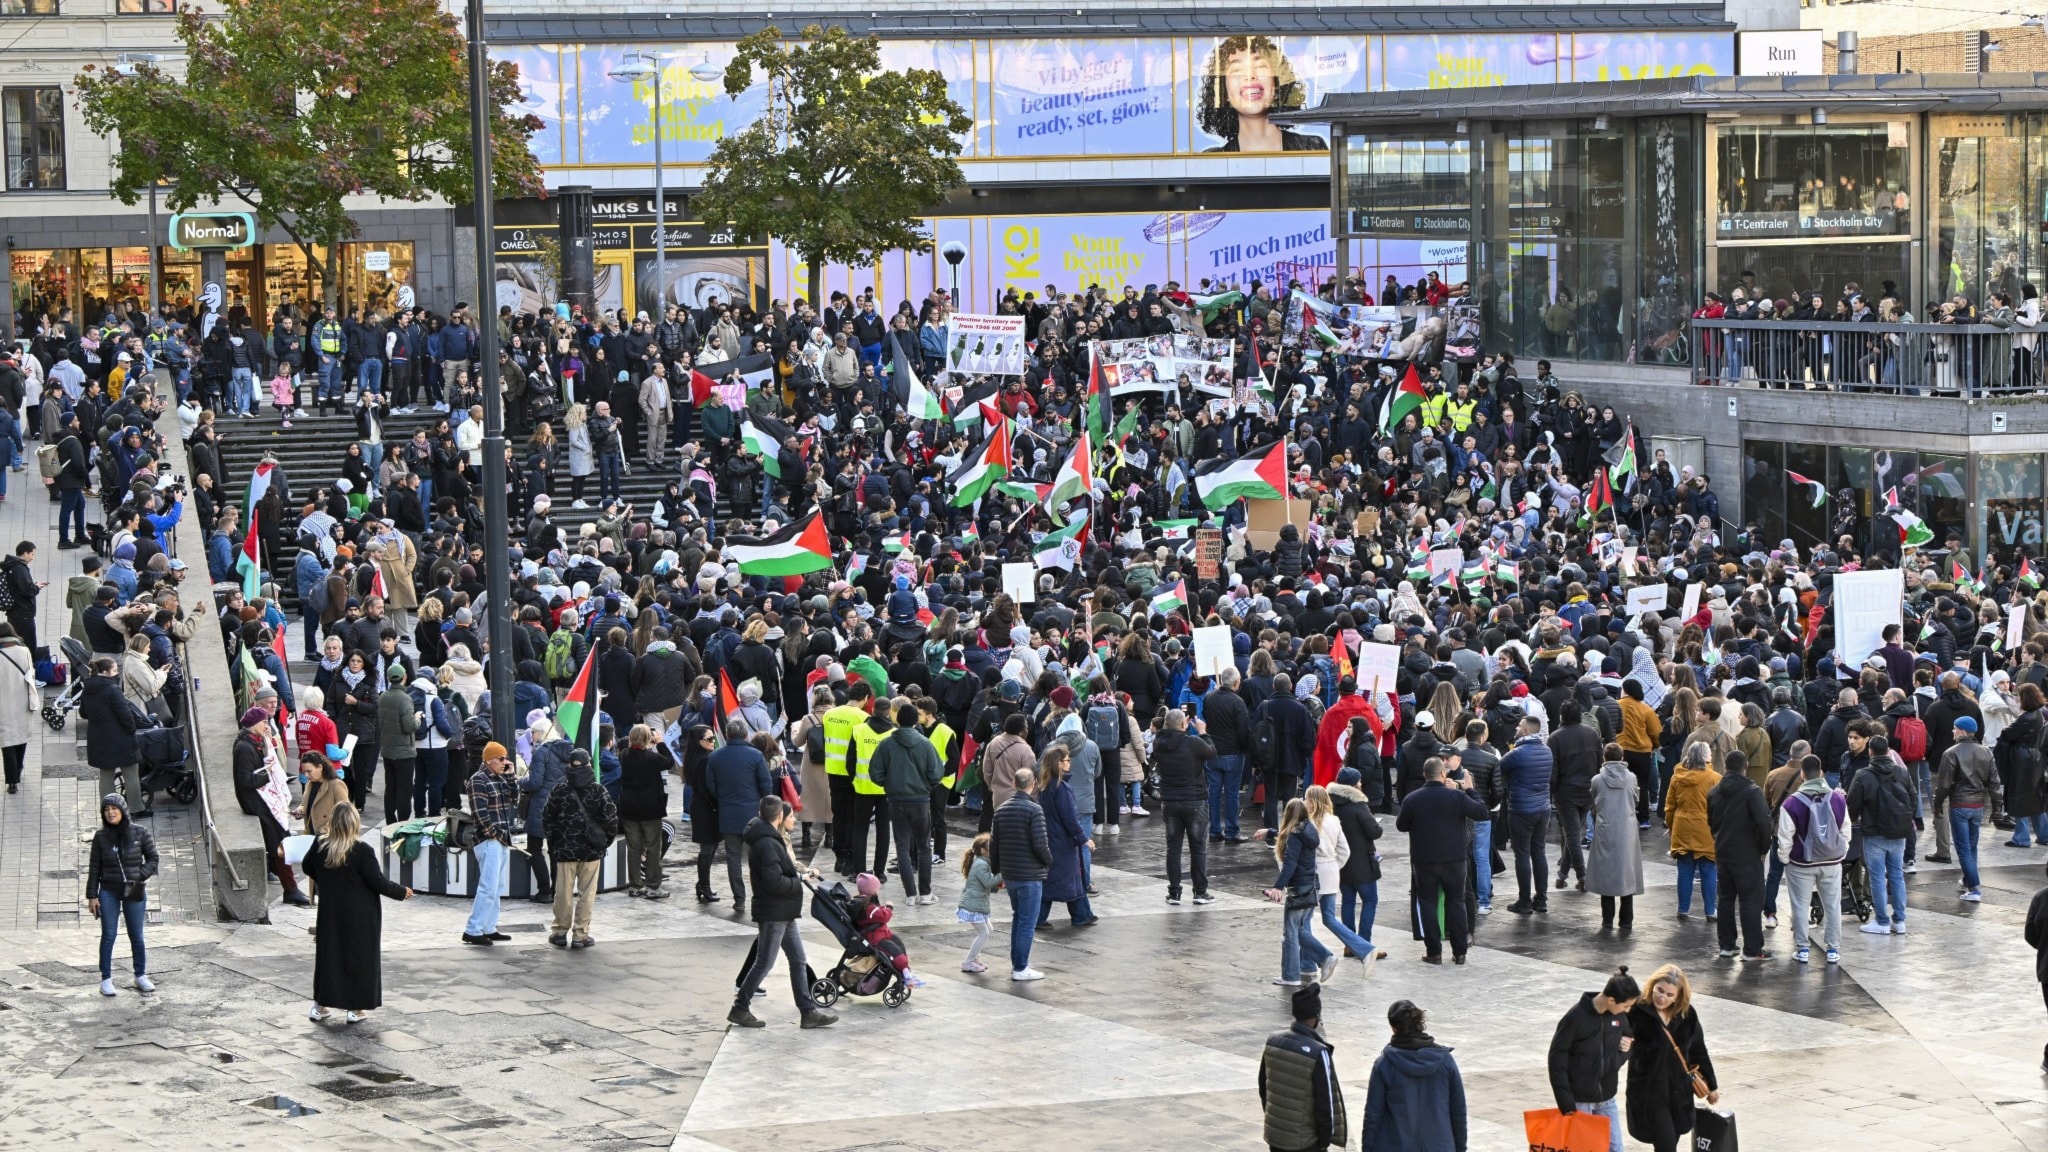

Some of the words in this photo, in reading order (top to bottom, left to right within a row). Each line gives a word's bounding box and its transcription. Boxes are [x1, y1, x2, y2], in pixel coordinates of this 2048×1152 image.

[1768, 46, 1796, 60] Run
[1038, 66, 1057, 87] Vi
[1061, 58, 1122, 83] bygger
[1018, 115, 1073, 139] ready,
[1077, 108, 1108, 128] set,
[1111, 96, 1159, 125] glow!
[184, 221, 240, 239] Normal
[1370, 216, 1405, 228] T-Centralen
[1423, 217, 1457, 229] Stockholm
[1458, 217, 1471, 231] City
[1734, 219, 1788, 230] T-Centralen
[1814, 215, 1862, 228] Stockholm
[1864, 216, 1883, 229] City
[501, 241, 537, 250] OMEGA
[1071, 233, 1125, 253] Your
[1210, 244, 1241, 267] Till
[1245, 236, 1280, 259] och
[1285, 223, 1325, 250] med
[1063, 251, 1145, 274] beauty
[828, 717, 850, 725] SECURITY
